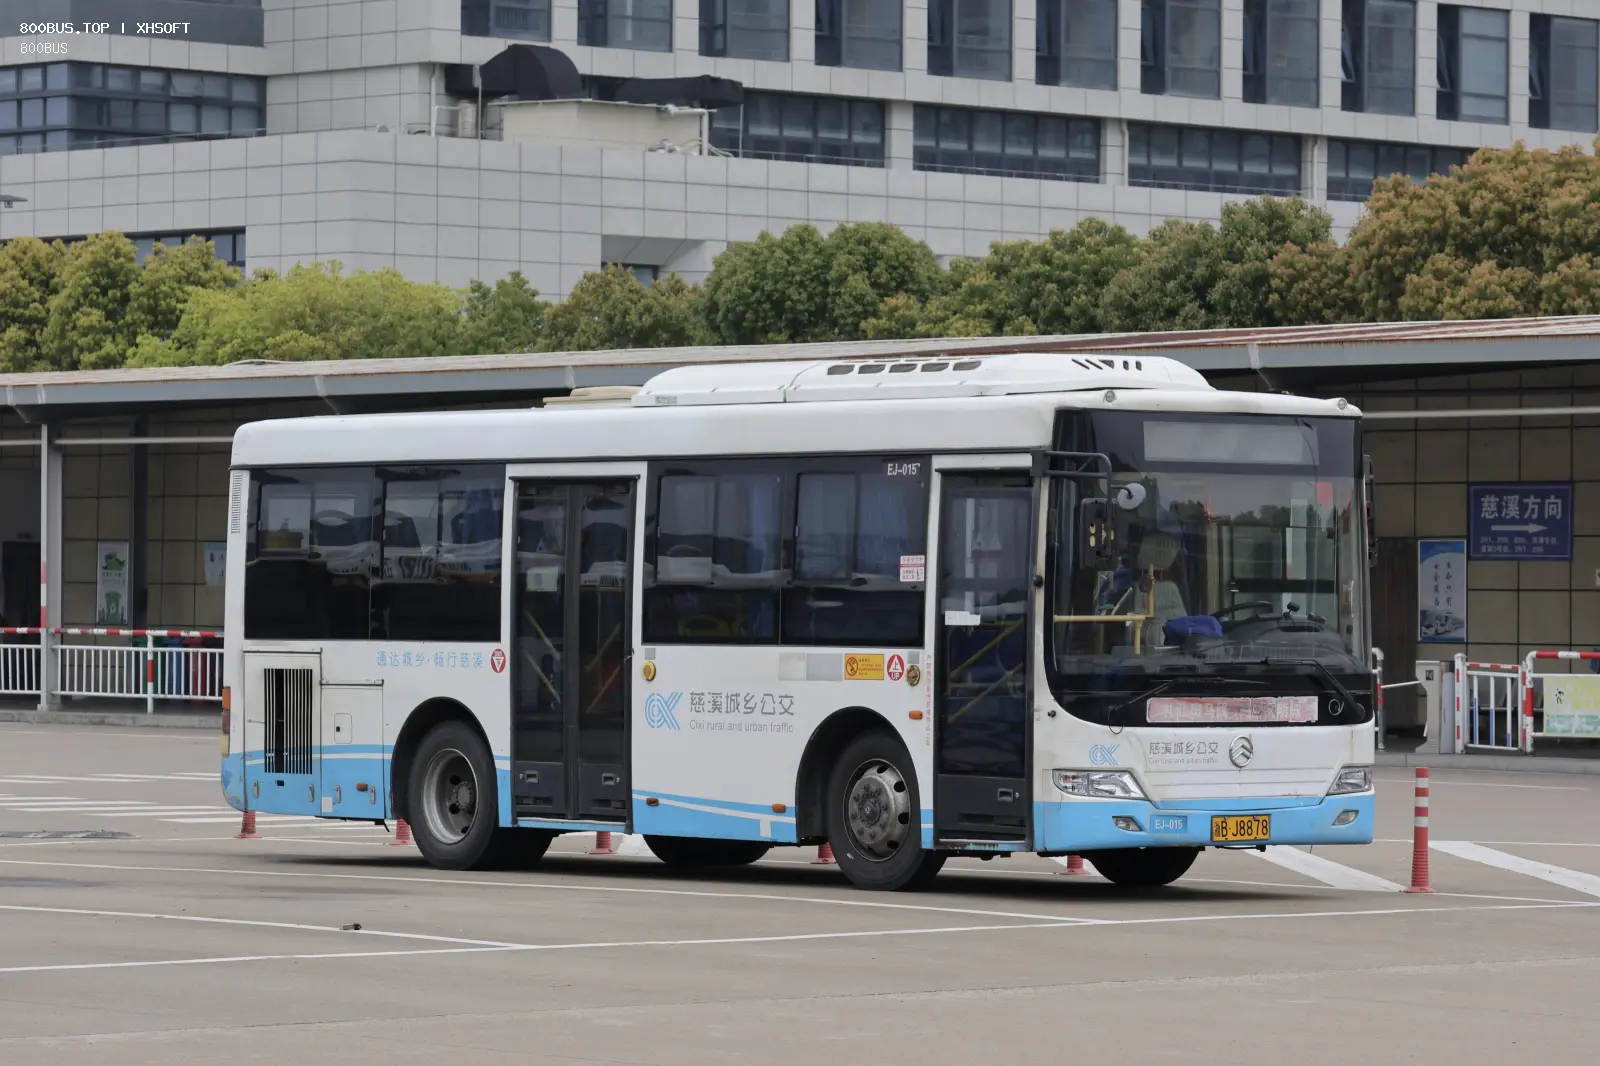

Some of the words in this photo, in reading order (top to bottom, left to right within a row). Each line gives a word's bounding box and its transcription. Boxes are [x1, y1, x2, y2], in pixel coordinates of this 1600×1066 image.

[887, 463, 917, 476] EJ-015
[1480, 494, 1562, 520] 慈溪方向
[376, 650, 484, 669] 通达城乡·畅行慈溪
[892, 659, 900, 671] 上
[891, 672, 900, 680] UP
[689, 691, 795, 716] 慈溪城乡公交
[689, 719, 705, 730] Cixi
[706, 720, 725, 731] rural
[728, 720, 742, 732] and
[745, 721, 768, 732] urban
[770, 721, 794, 733] traffic
[1149, 741, 1219, 755] 慈溪城乡公交
[1154, 818, 1183, 830] EJ-015
